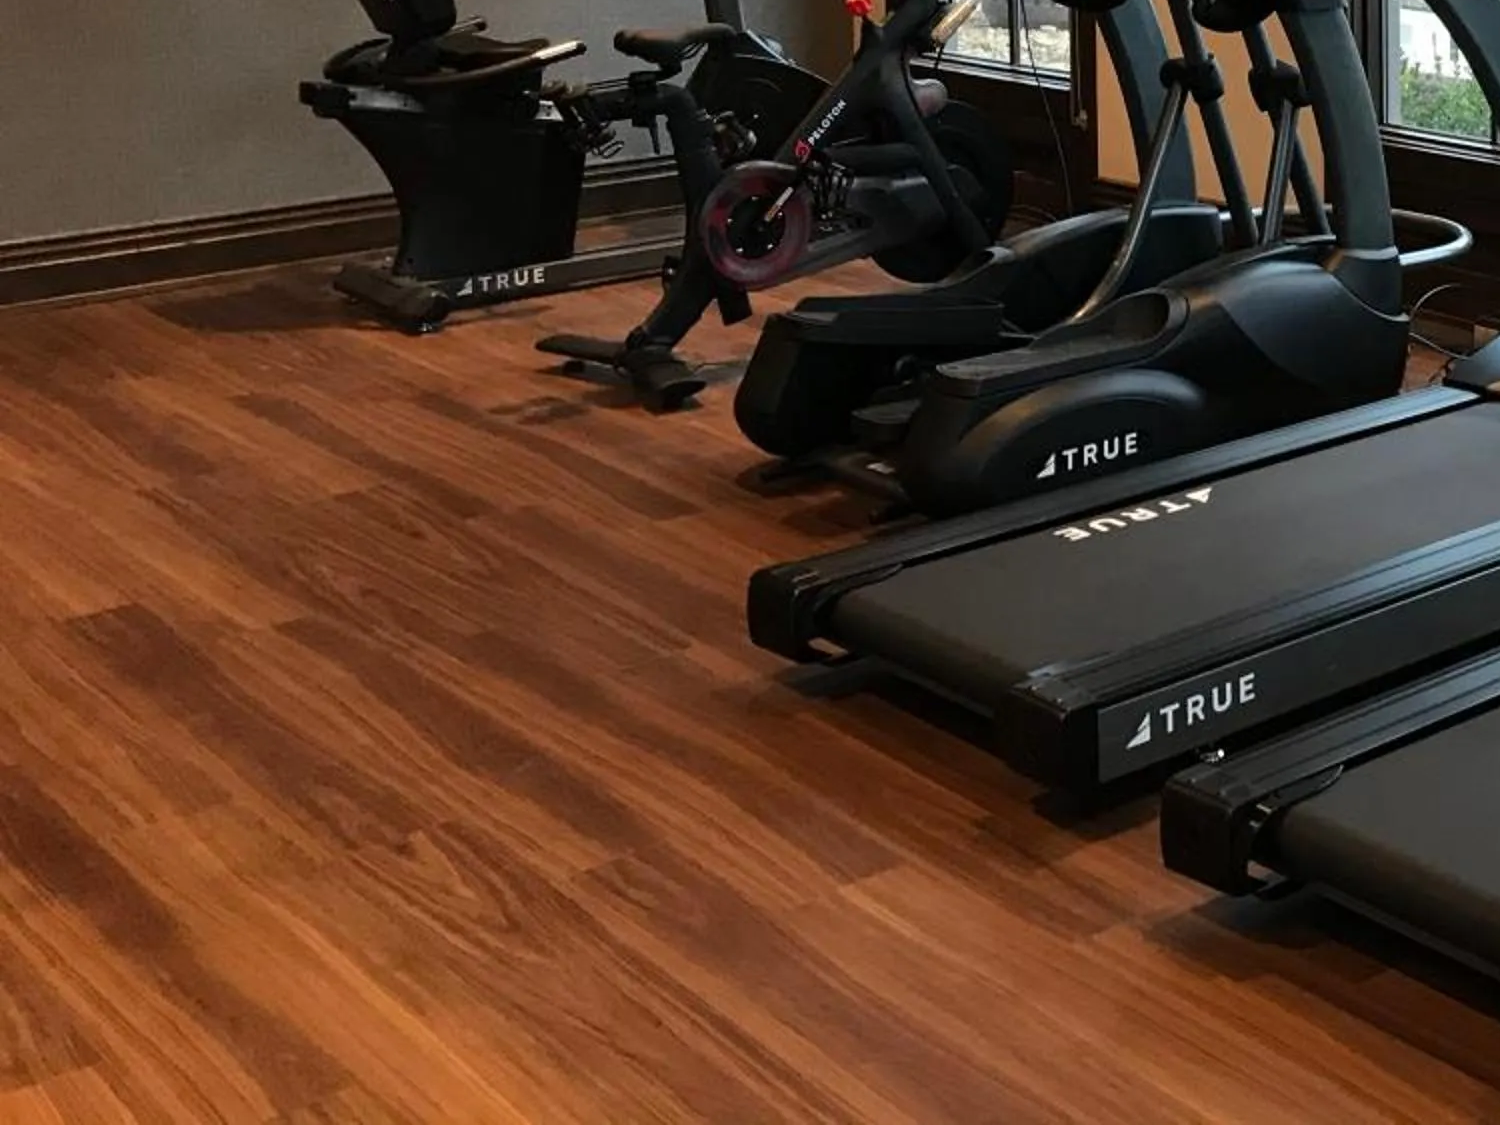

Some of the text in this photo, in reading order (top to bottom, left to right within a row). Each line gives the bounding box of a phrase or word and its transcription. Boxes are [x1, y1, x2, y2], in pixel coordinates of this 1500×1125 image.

[807, 99, 847, 146] PELOTON
[477, 266, 545, 292] TRUE
[1062, 432, 1139, 471] TRUE
[1053, 500, 1192, 542] TRUE
[1159, 672, 1256, 734] TRUE
